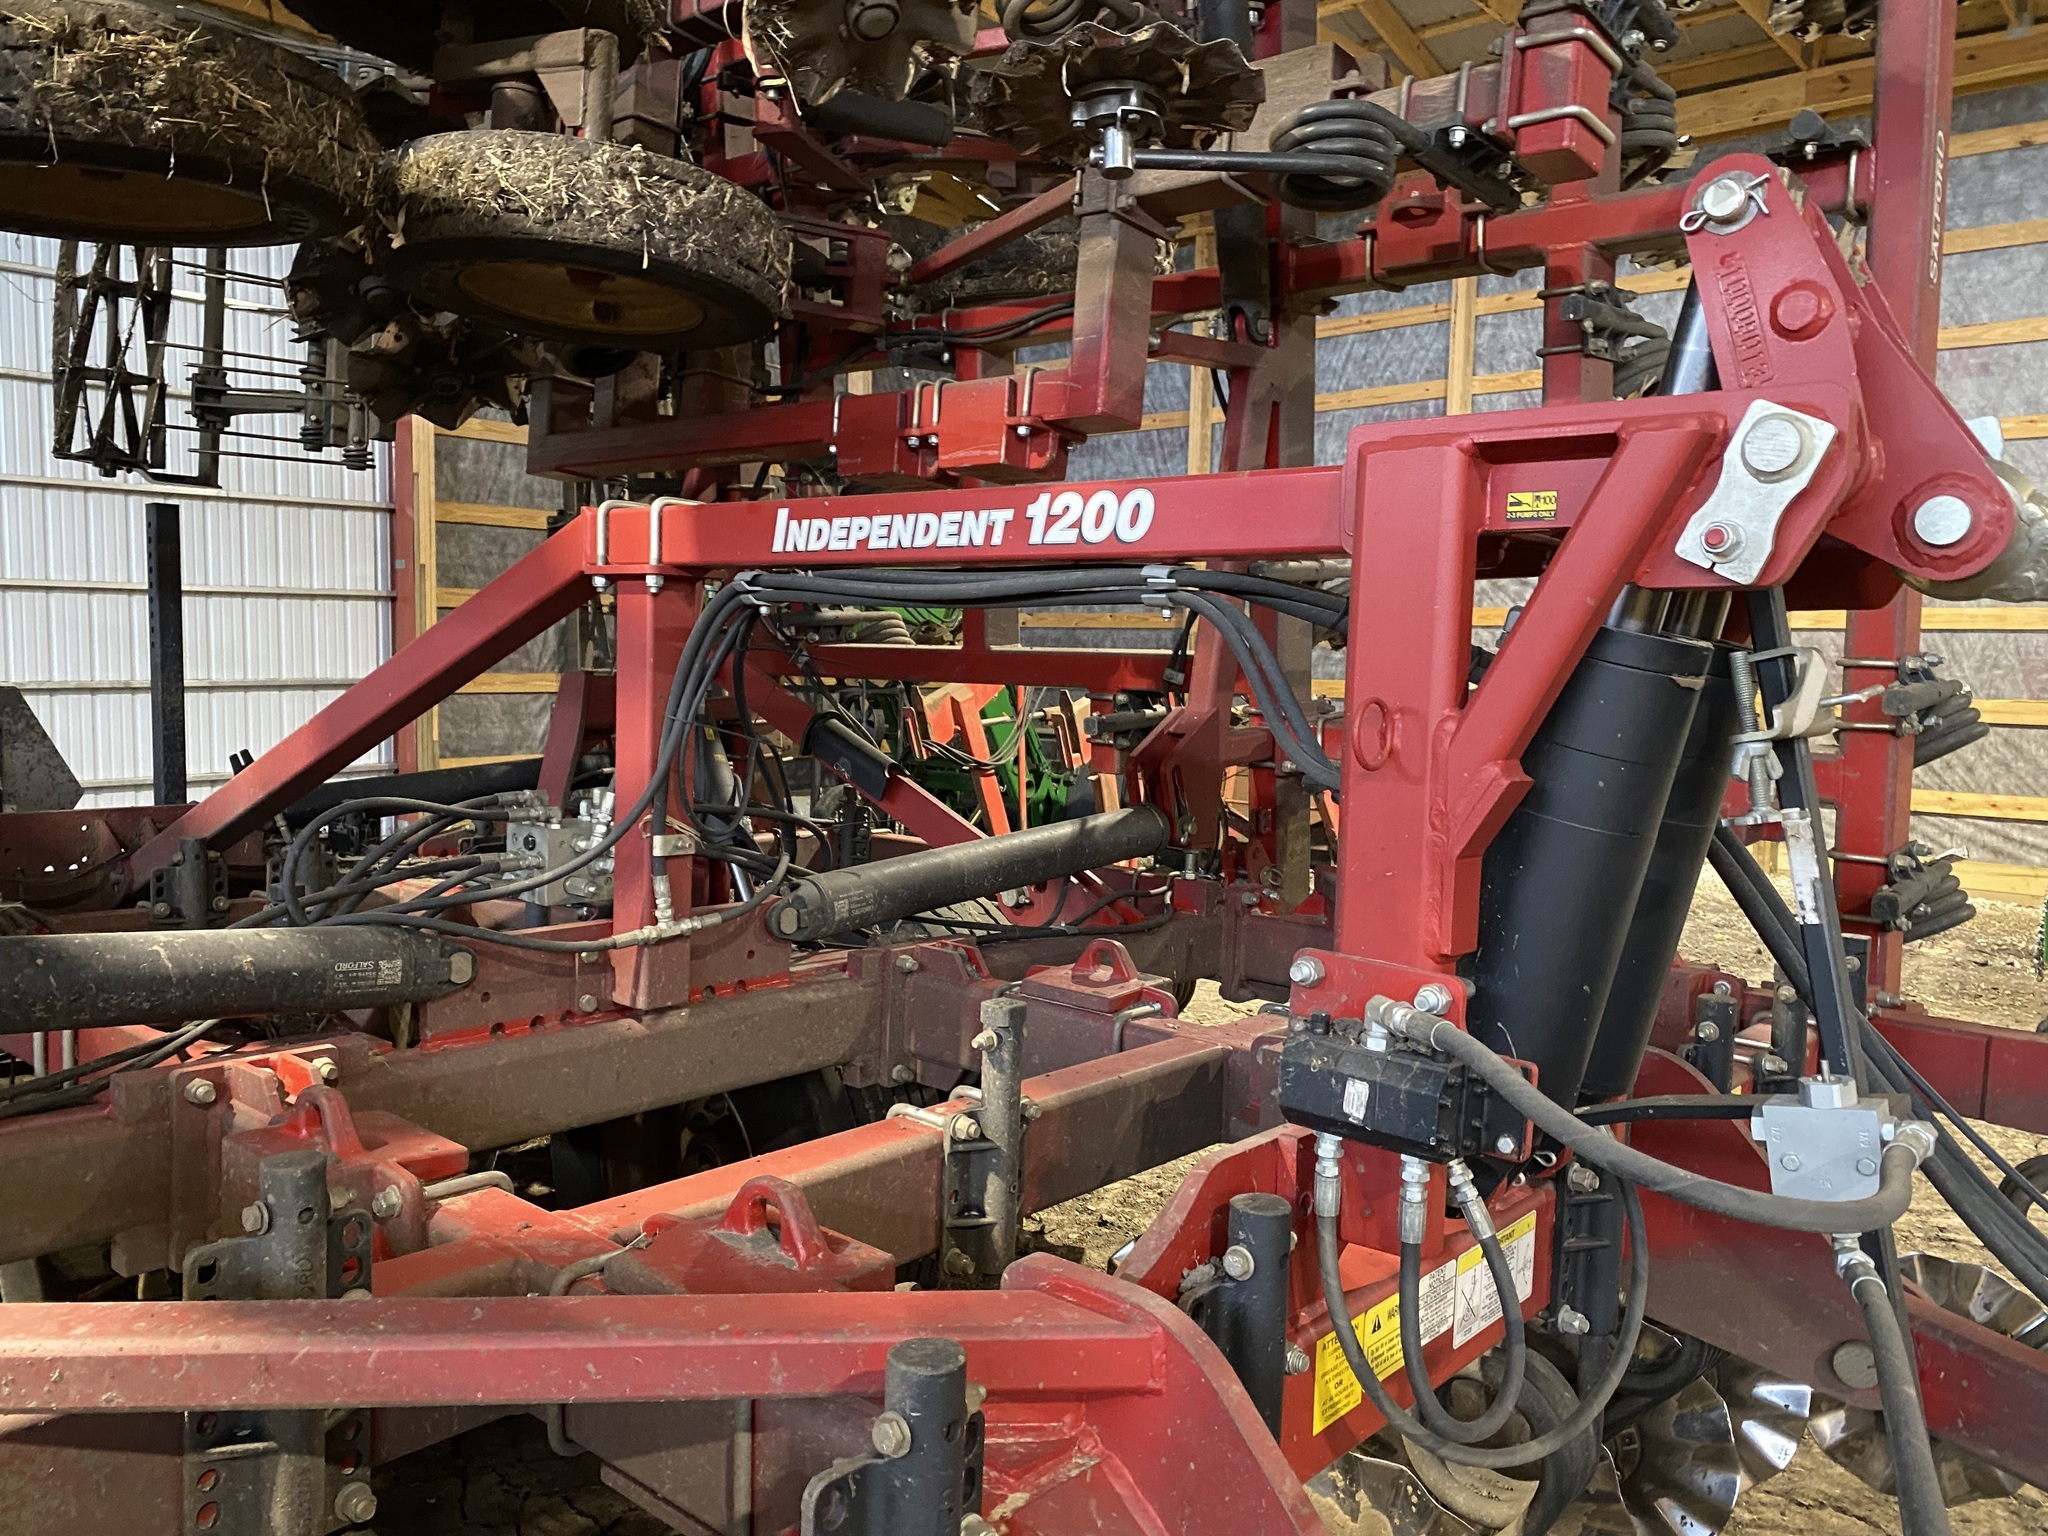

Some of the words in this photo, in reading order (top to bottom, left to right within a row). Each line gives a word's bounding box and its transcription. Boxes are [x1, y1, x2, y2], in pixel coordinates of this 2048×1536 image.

[1929, 130, 1945, 284] SALFORD
[772, 507, 1014, 553] INDEPENDENT
[1025, 488, 1156, 545] 1200
[335, 961, 375, 971] SALFORD
[1428, 1265, 1447, 1281] PATENT
[1334, 1378, 1343, 1390] OR
